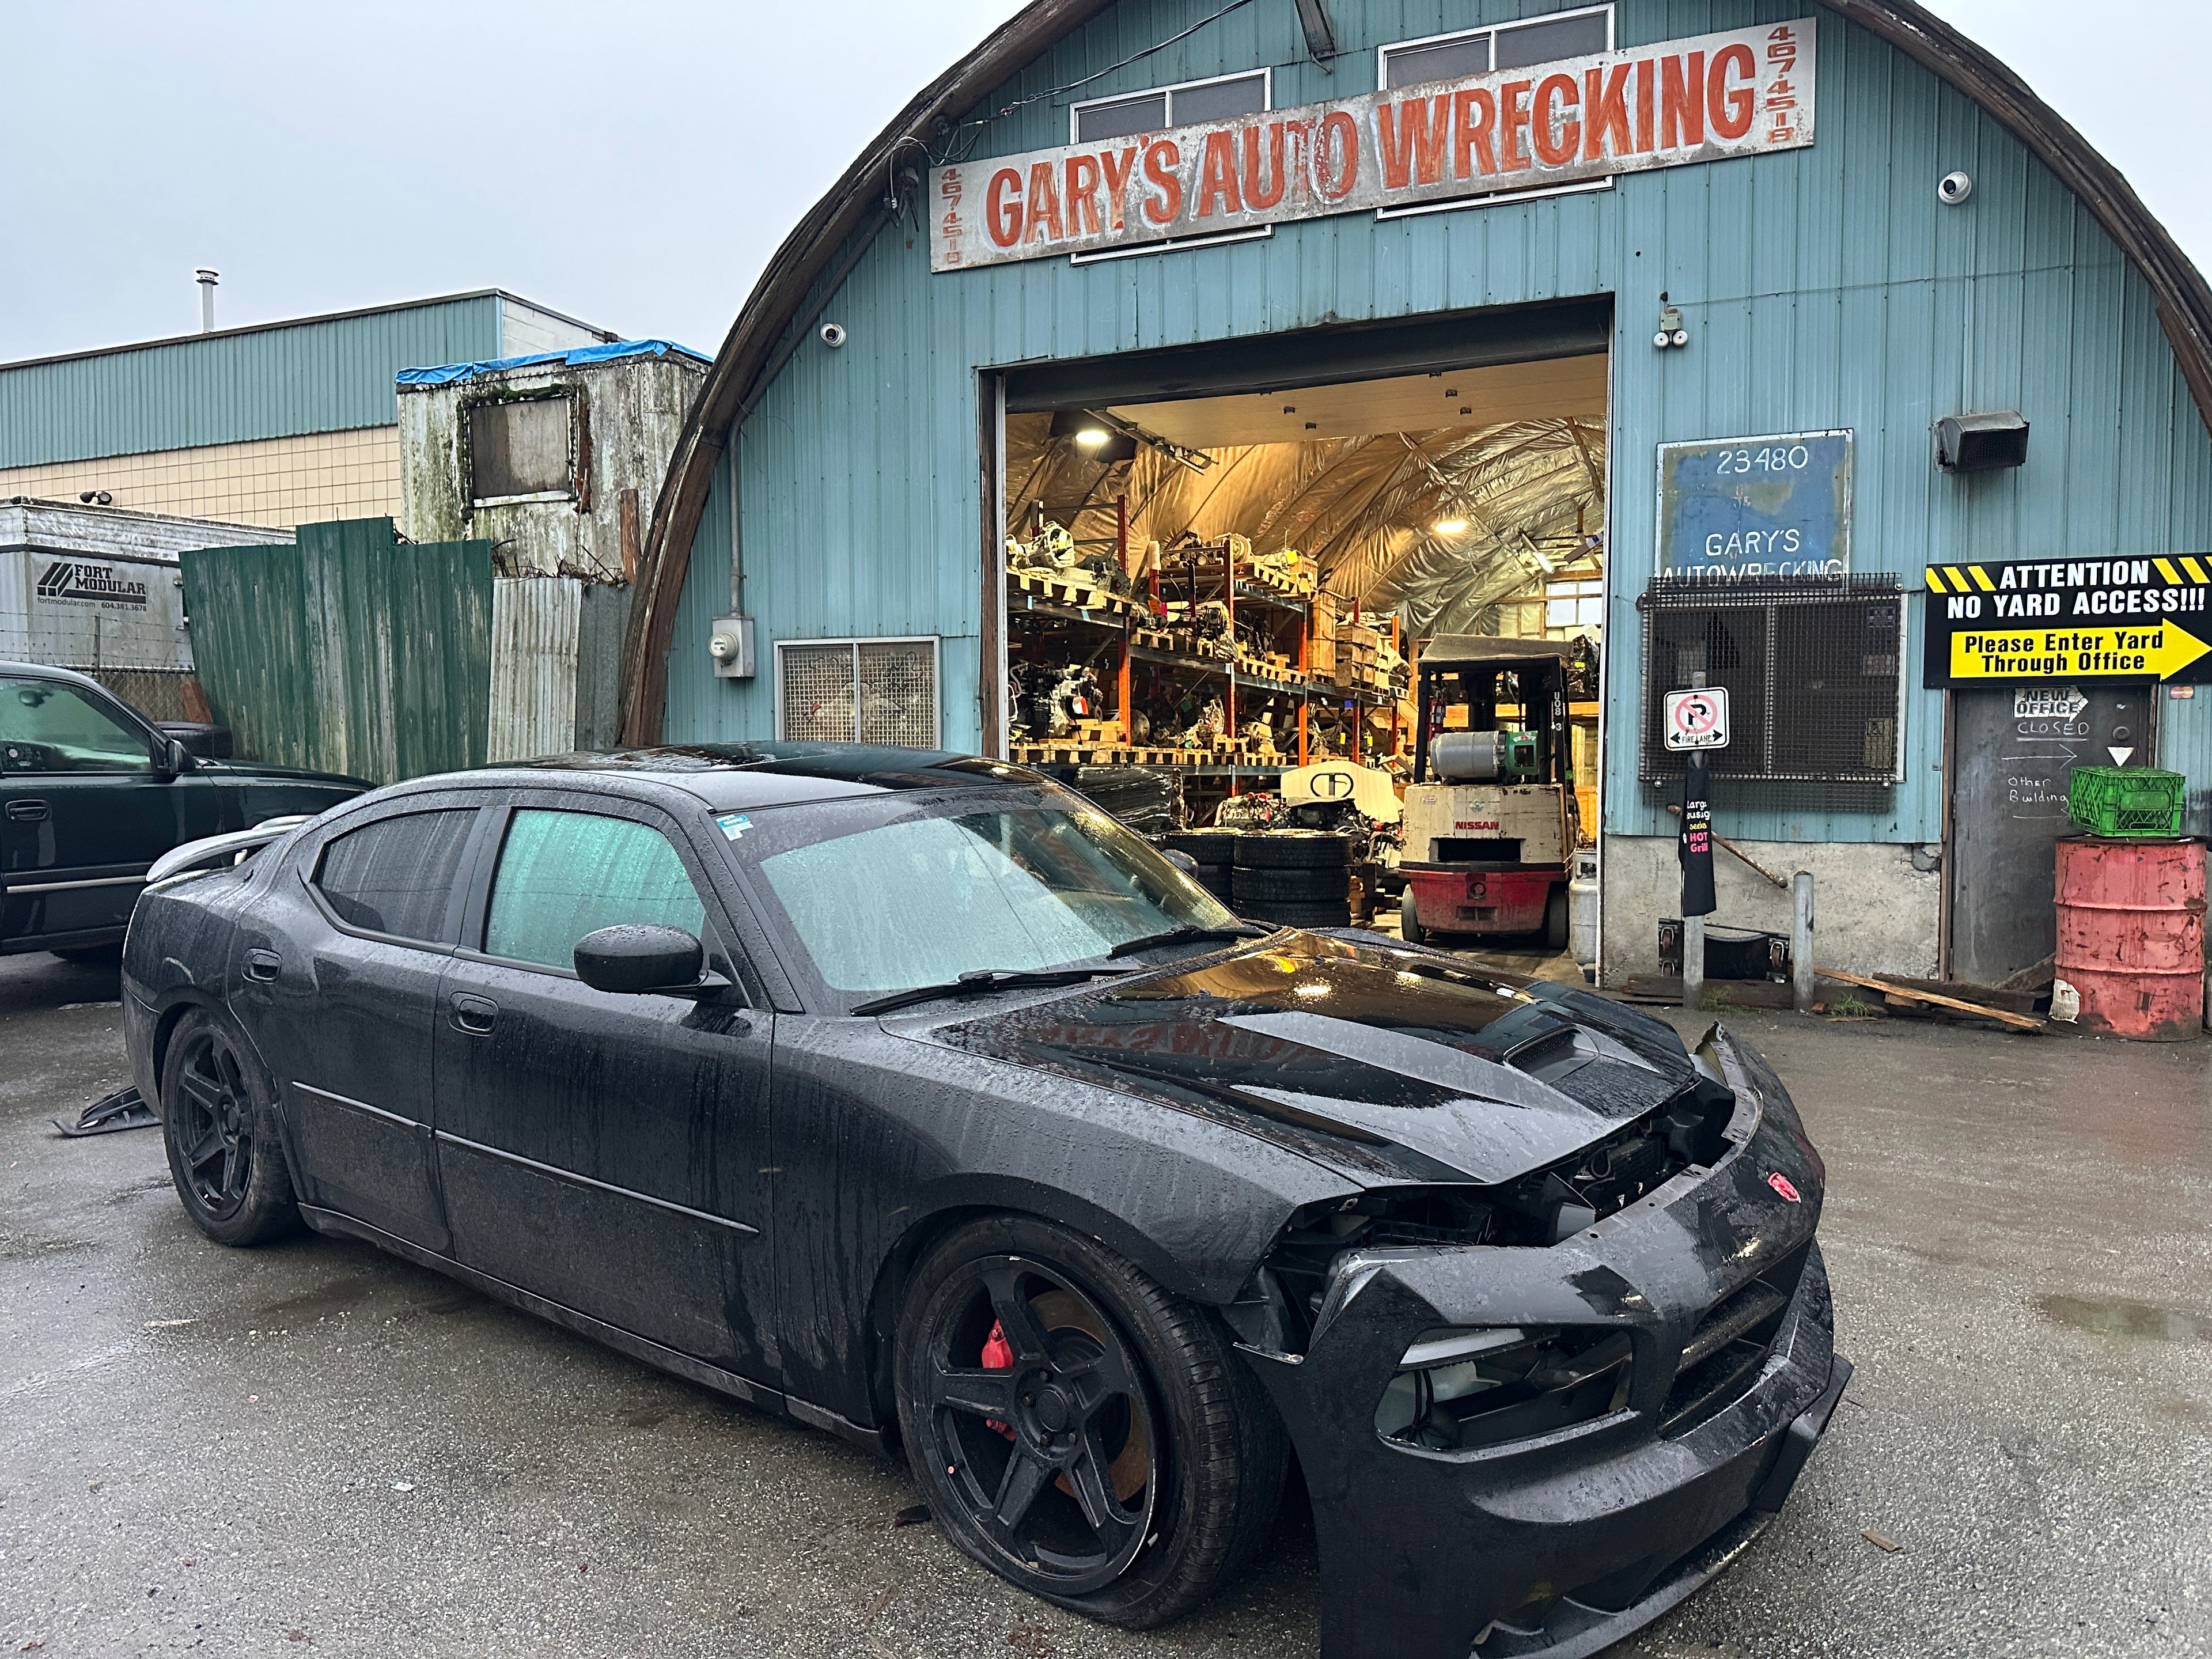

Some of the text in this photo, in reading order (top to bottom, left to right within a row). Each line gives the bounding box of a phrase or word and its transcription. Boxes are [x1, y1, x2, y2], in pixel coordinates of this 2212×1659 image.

[986, 43, 1756, 248] GARY'S AUTO WRECKING
[1716, 445, 1809, 475] 23480
[1705, 528, 1800, 556] GARY'S
[74, 564, 113, 579] FORT
[1999, 560, 2149, 589] ATTENTION
[75, 577, 146, 595] MODULAR
[37, 596, 147, 612] fortmodular.com 604.381.3678
[1947, 588, 2205, 619] NO YARD ACCESS!!!
[1965, 630, 2164, 653] Please Enter Yard
[1981, 652, 2145, 675] Through Office
[2024, 690, 2069, 702] NEW
[2016, 701, 2080, 715] OFFICE
[2017, 720, 2090, 735] CLOSED
[1682, 736, 1694, 744] FIRE
[2009, 789, 2069, 808] Building
[1455, 821, 1499, 830] NISSAN
[1689, 821, 1707, 830] seeks
[1690, 832, 1708, 842] HOT
[1690, 842, 1709, 853] Grill
